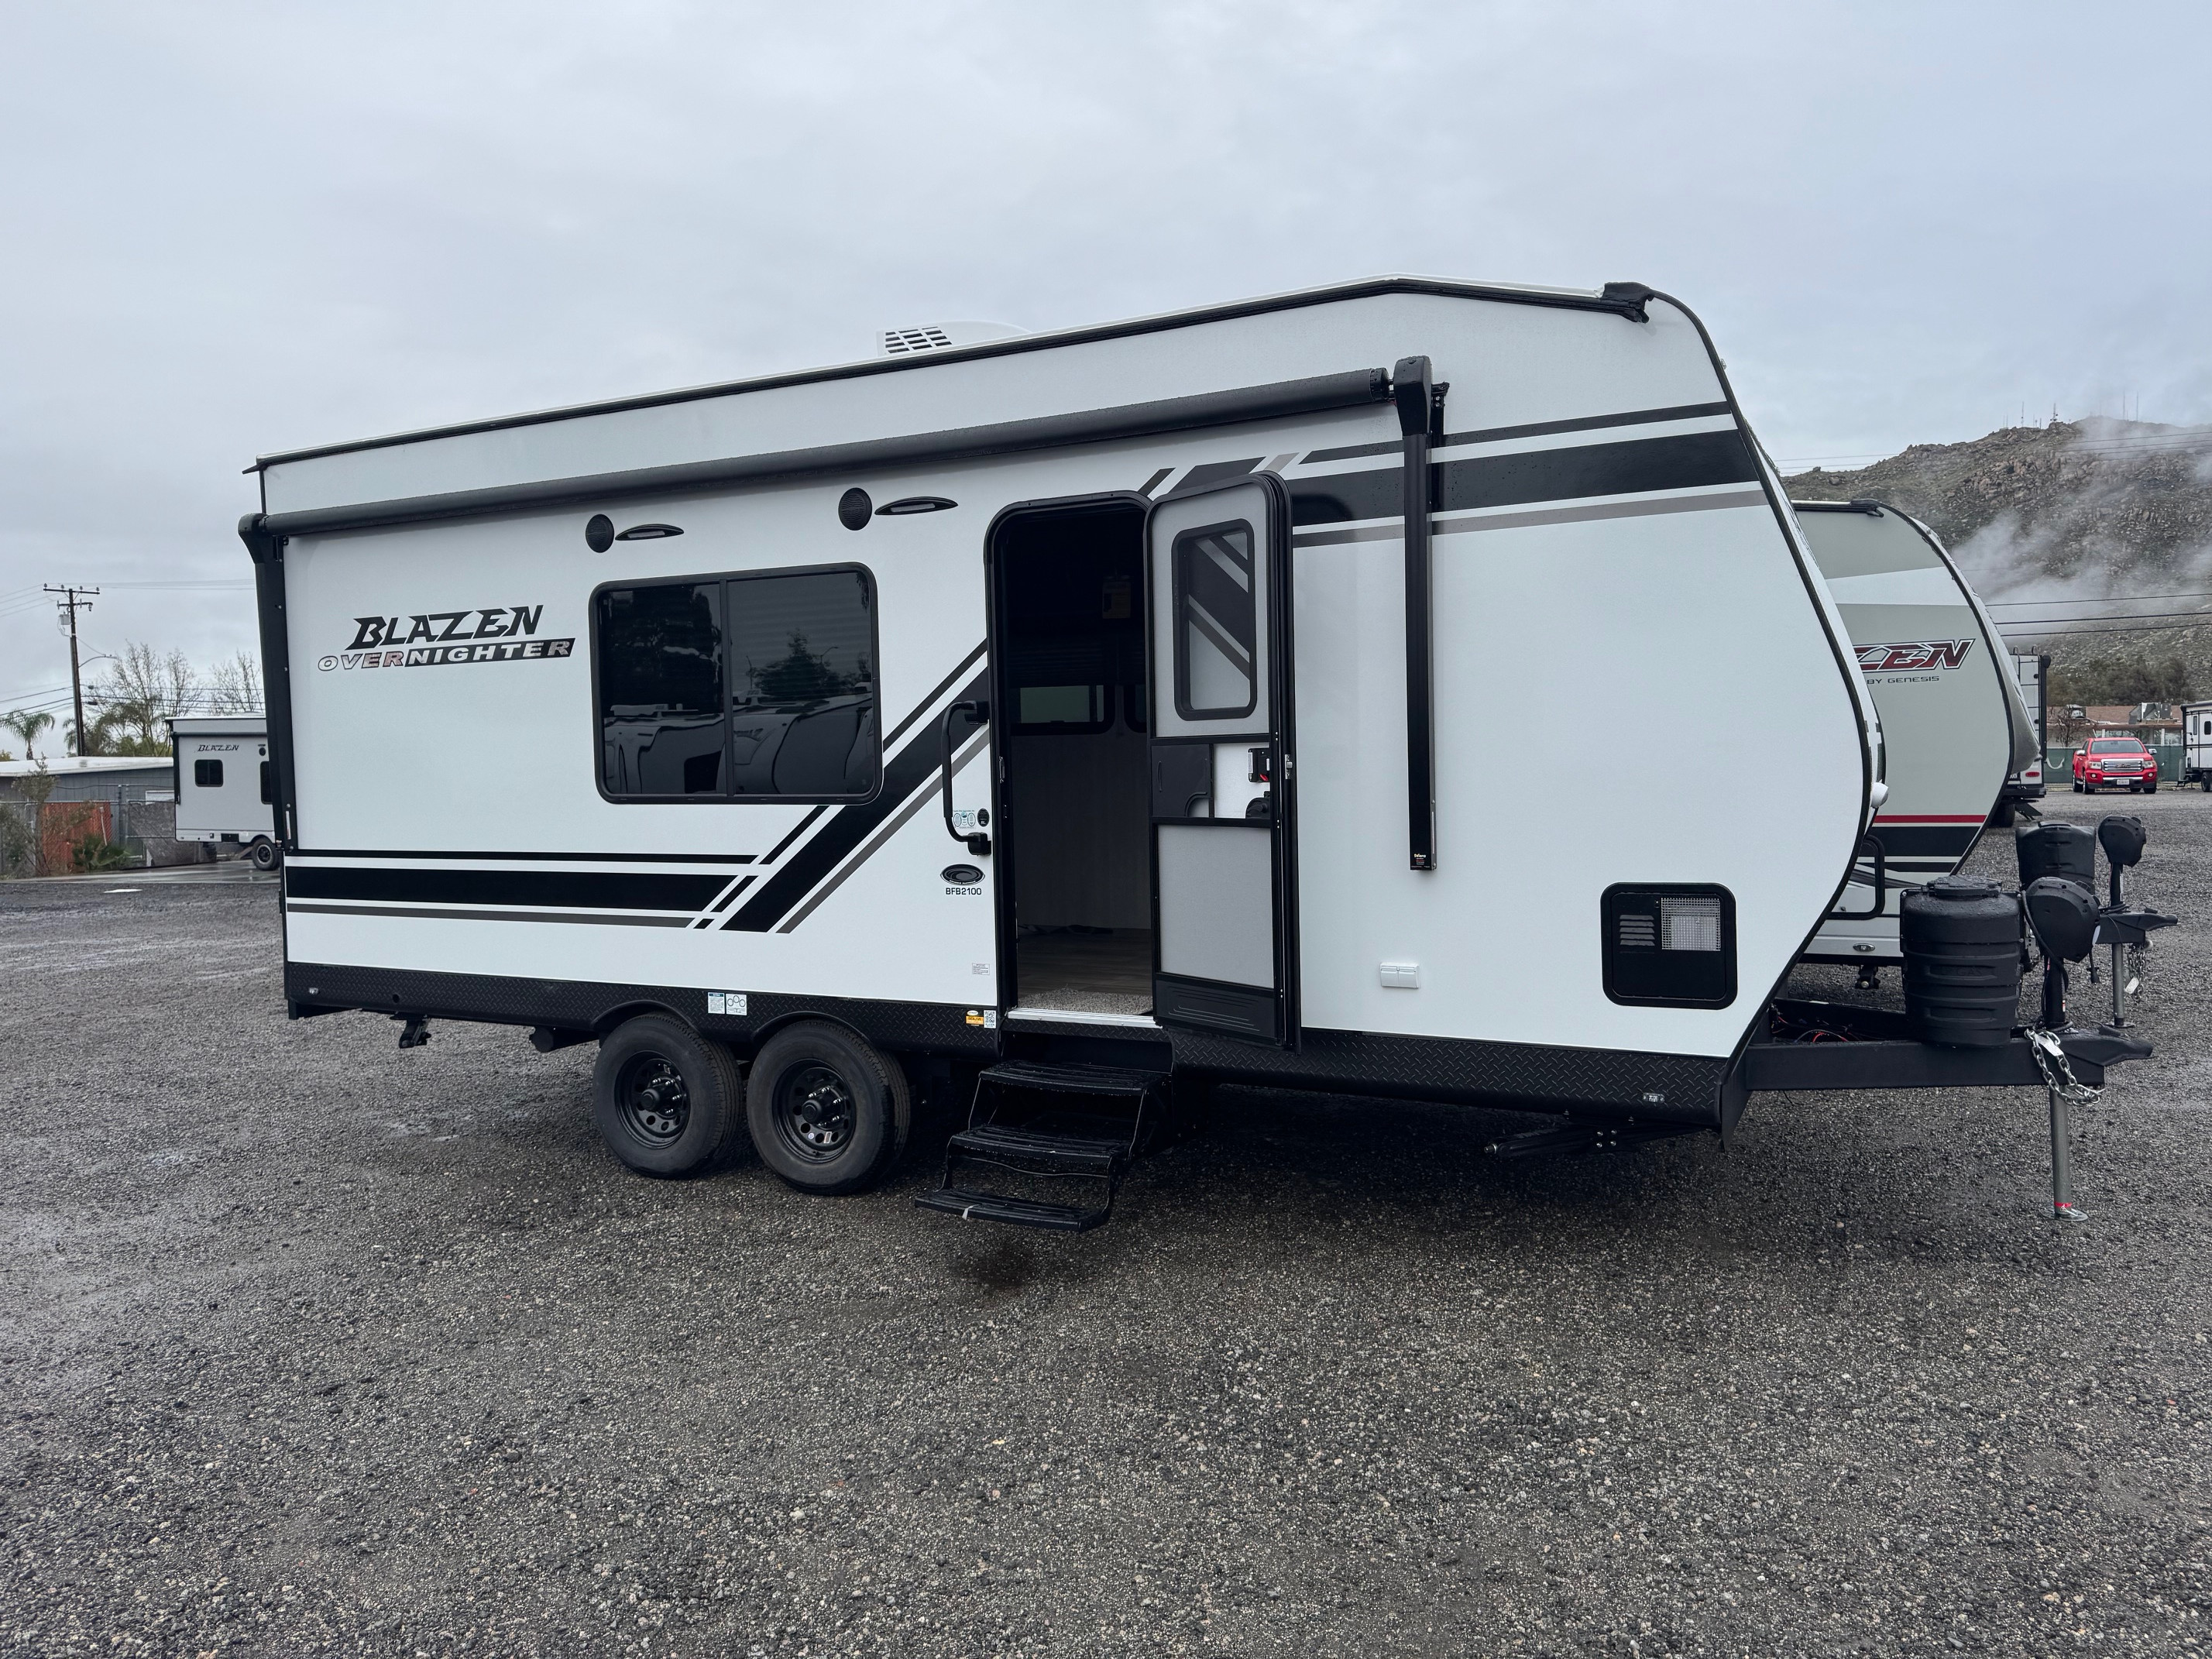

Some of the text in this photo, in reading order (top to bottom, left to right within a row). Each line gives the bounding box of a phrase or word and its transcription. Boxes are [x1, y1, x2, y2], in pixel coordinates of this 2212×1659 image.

[345, 604, 544, 651] BLAZEN
[318, 640, 572, 672] OVERNIGHTER
[1887, 675, 1939, 684] GENESIS
